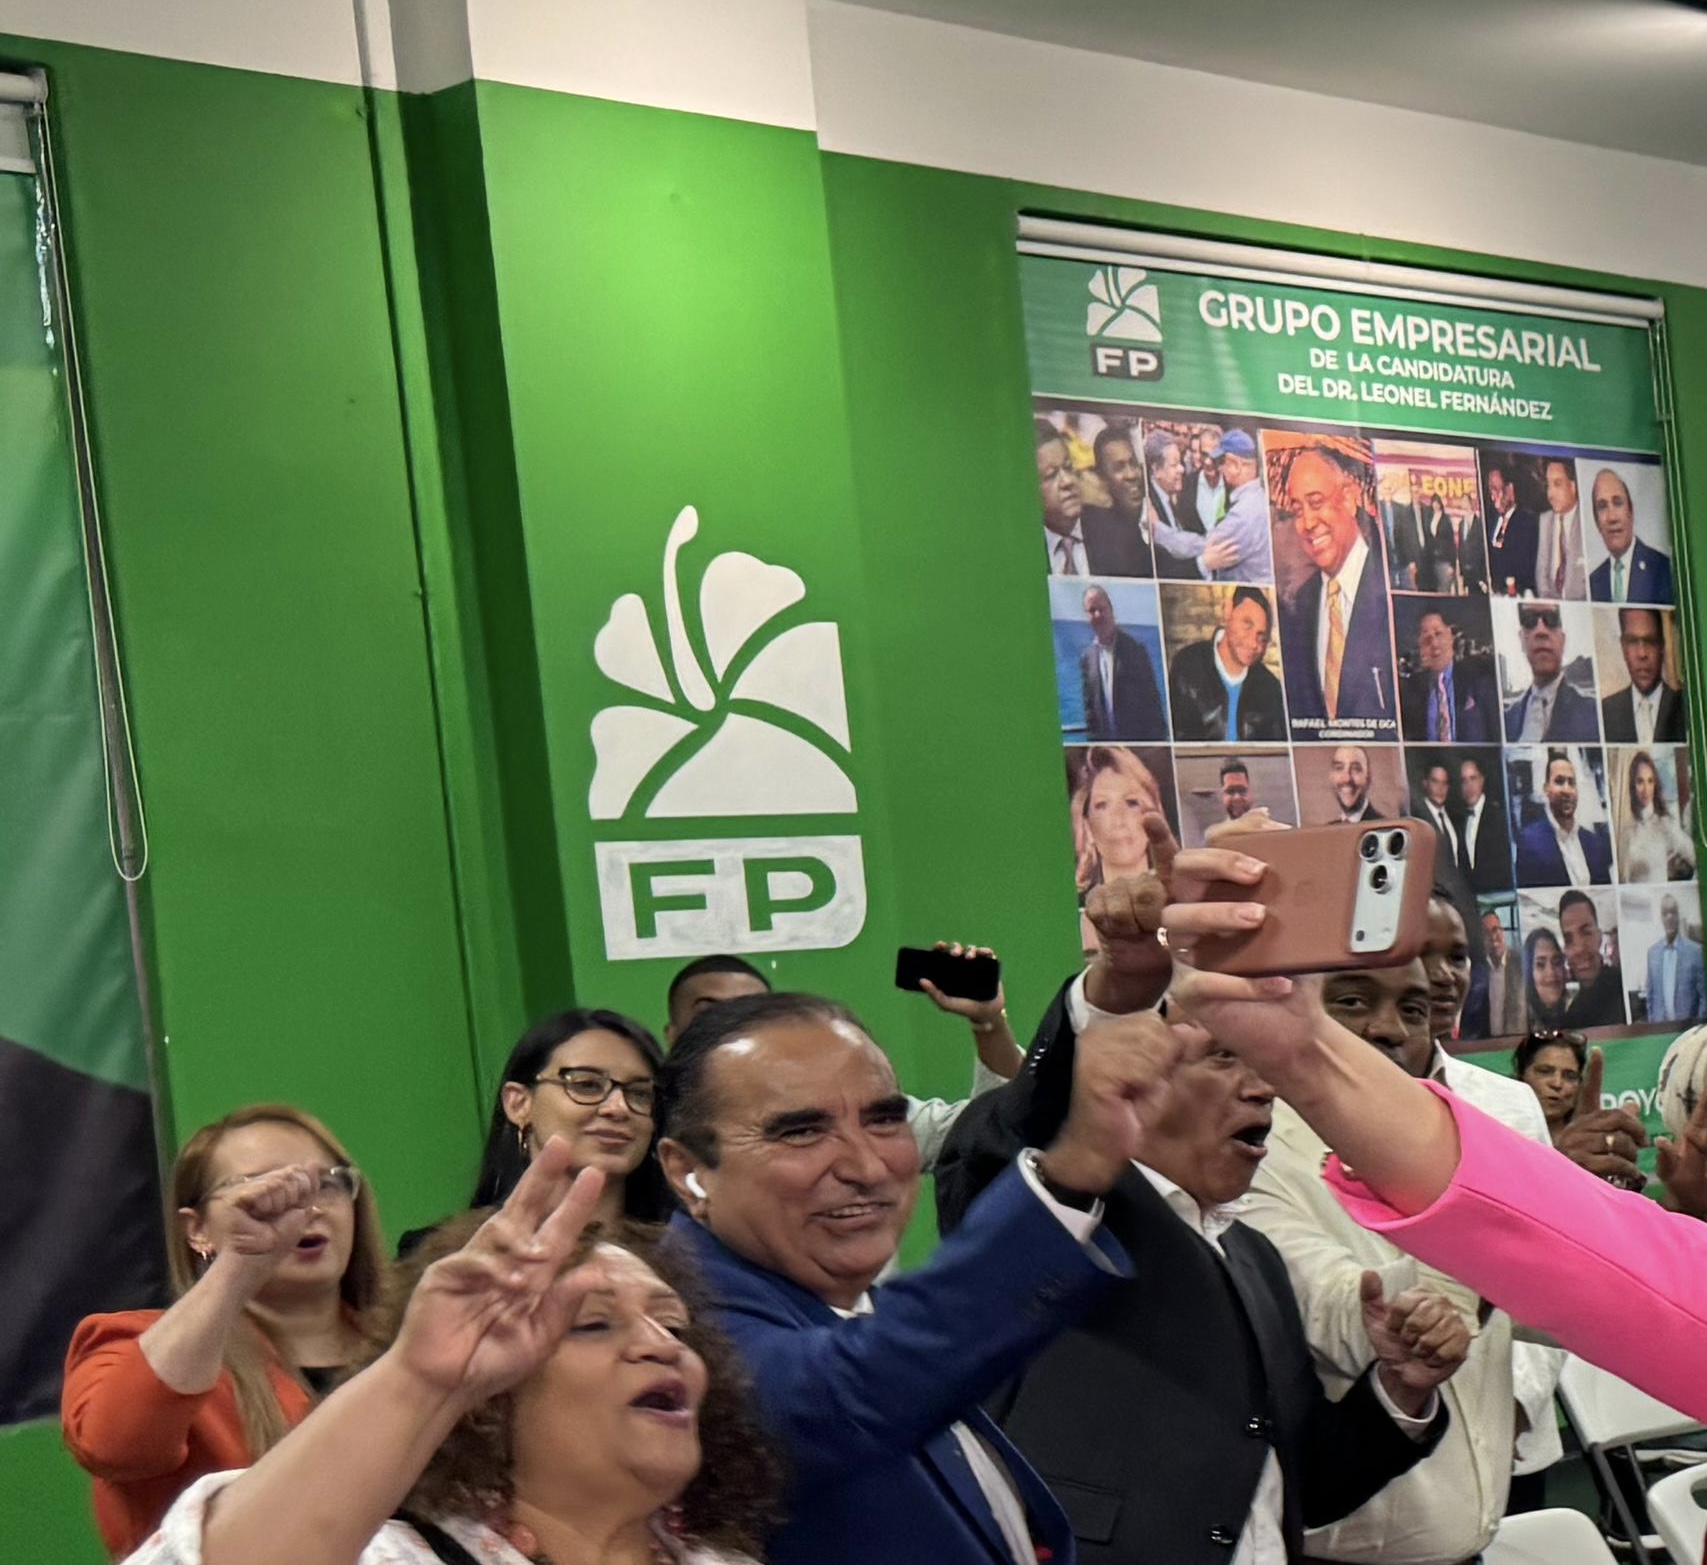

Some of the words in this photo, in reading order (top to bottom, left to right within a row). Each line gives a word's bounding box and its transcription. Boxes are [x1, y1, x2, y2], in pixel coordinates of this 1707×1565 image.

[1199, 290, 1341, 341] GRUPO
[1350, 308, 1602, 372] EMPRESARIAL
[1096, 346, 1158, 377] FP
[1309, 347, 1339, 370] DE
[1347, 351, 1375, 374] LA
[1376, 355, 1516, 390] CANDIDATURA
[1277, 372, 1320, 397] DEL
[1322, 377, 1358, 401] DR.
[1360, 380, 1438, 409] LEONEL
[1440, 390, 1553, 420] FERNÁNDEZ
[628, 855, 837, 940] FP
